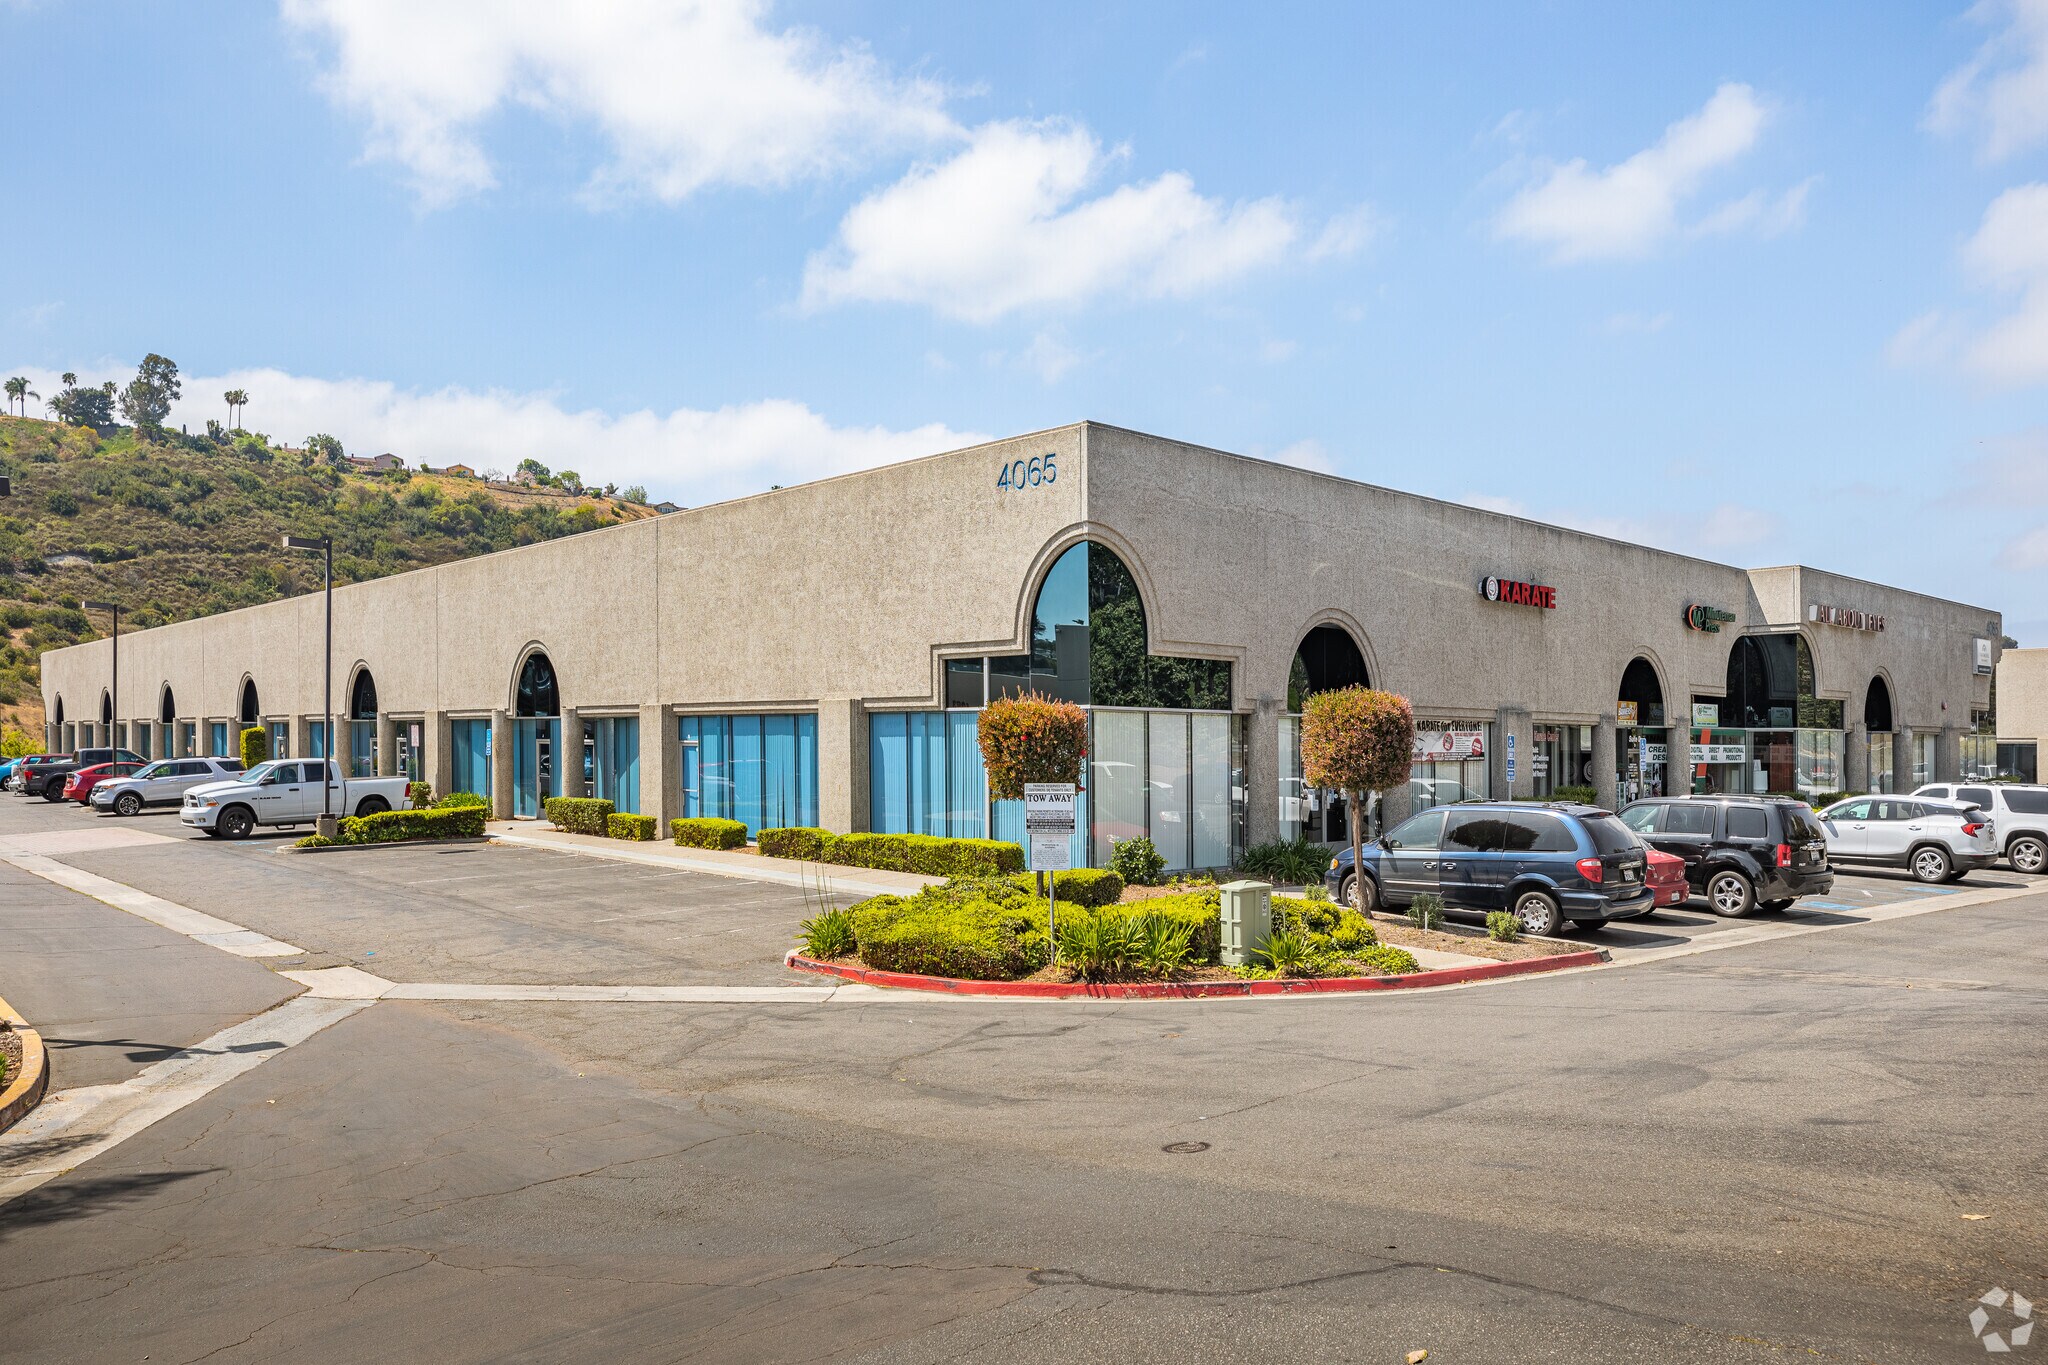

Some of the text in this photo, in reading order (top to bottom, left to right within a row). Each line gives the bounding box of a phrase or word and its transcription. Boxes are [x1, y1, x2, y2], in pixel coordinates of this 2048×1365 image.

[998, 453, 1057, 491] 4065
[1500, 579, 1556, 609] KARATE
[1416, 720, 1440, 731] KARATE
[1028, 794, 1072, 803] TOW AWAY
